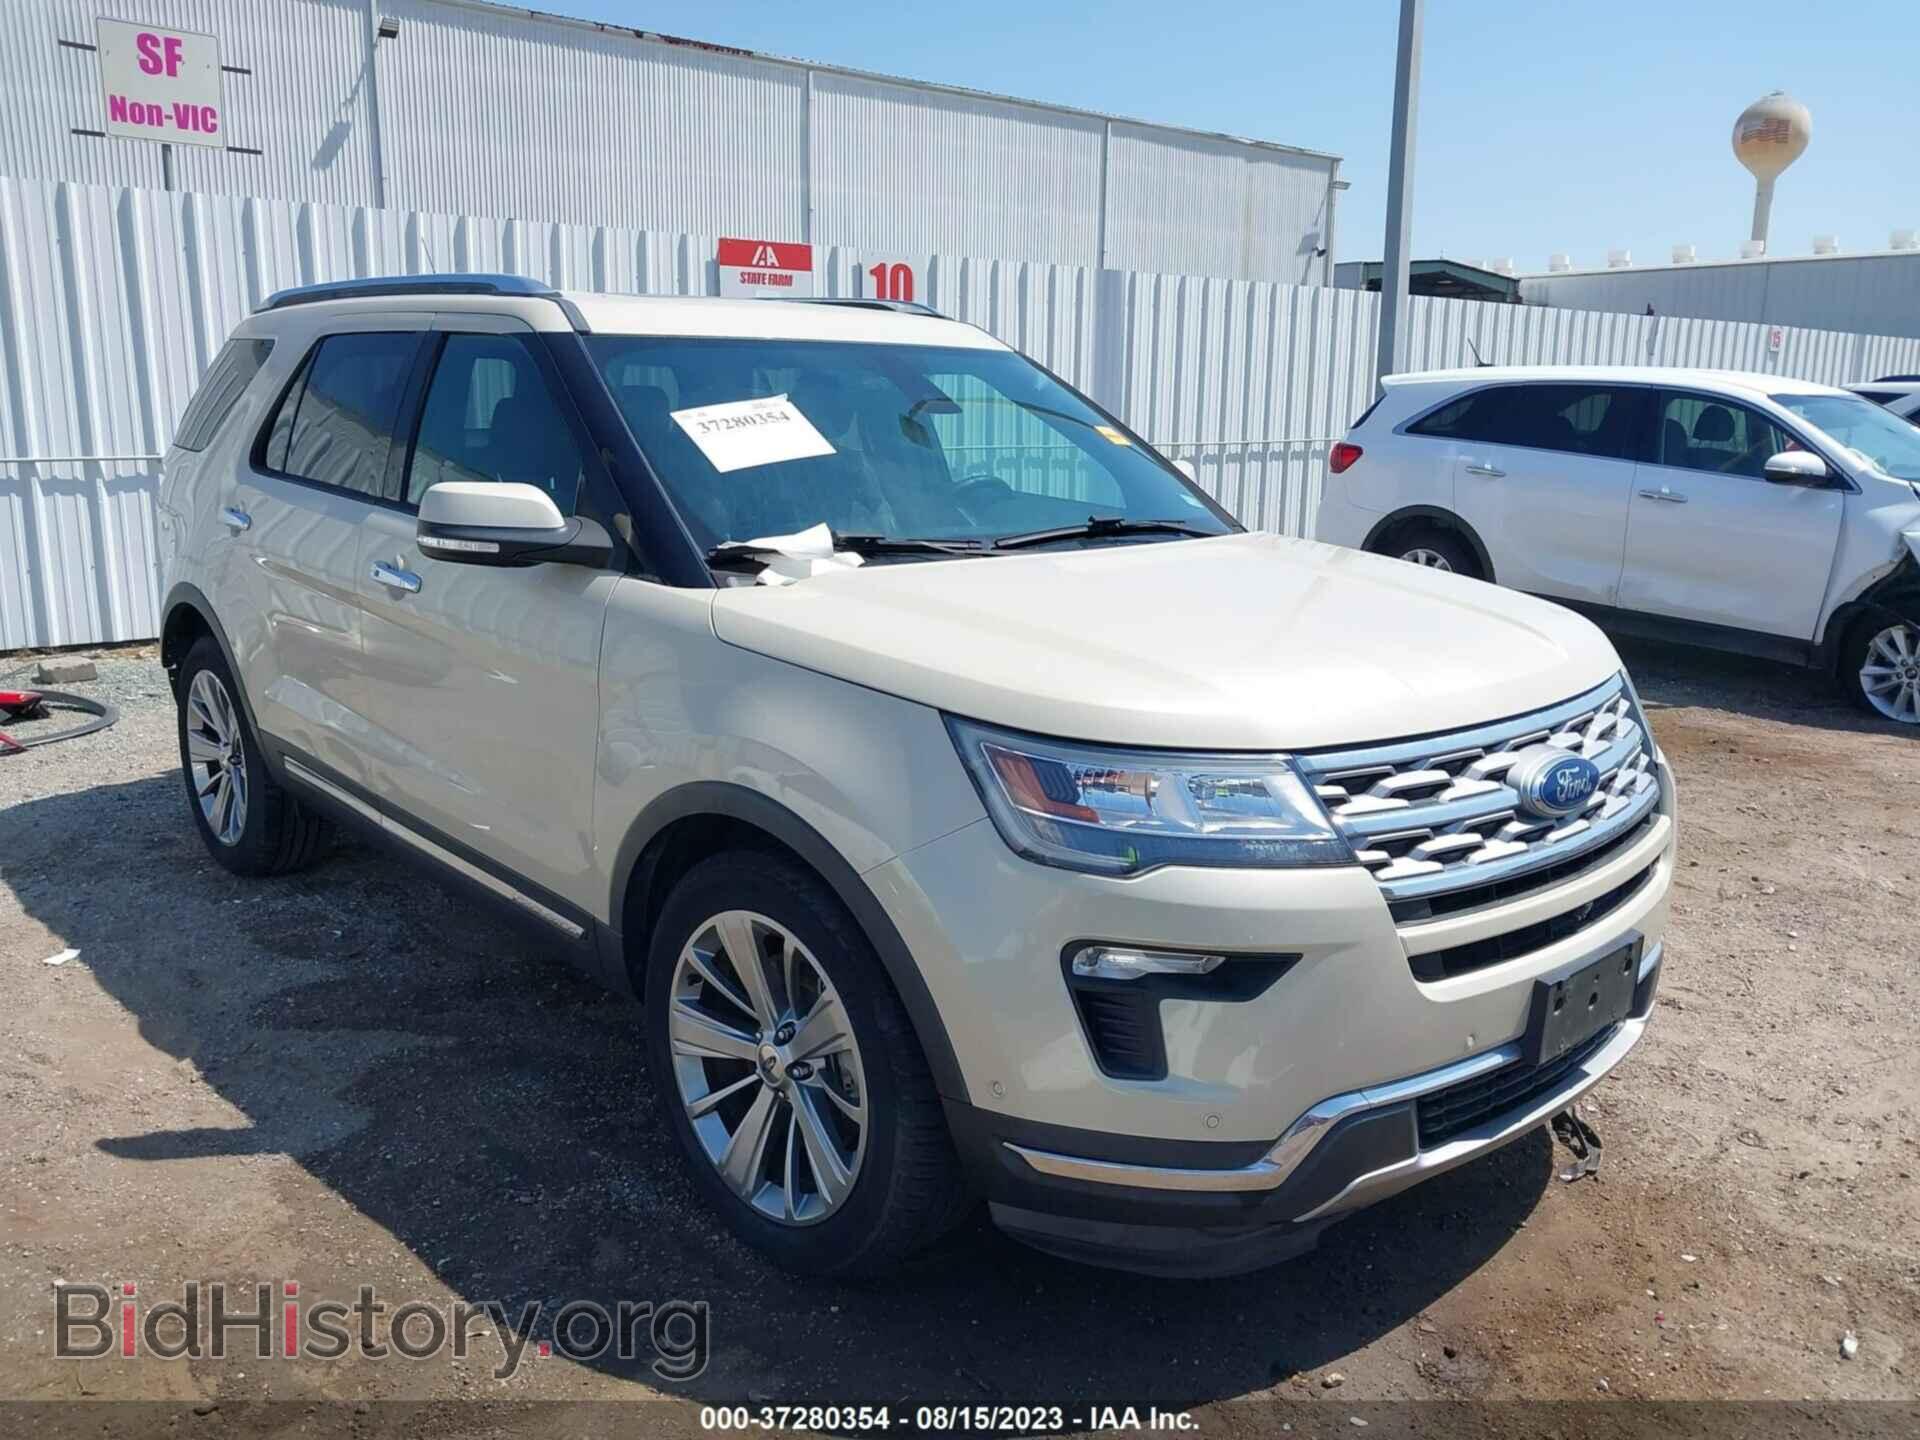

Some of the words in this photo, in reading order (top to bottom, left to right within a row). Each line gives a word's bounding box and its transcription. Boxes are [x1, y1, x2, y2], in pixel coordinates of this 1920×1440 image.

[137, 32, 182, 77] SF
[109, 94, 217, 133] Non-VIC
[740, 271, 766, 285] STATE
[768, 274, 793, 287] FARM
[869, 262, 914, 302] 10
[697, 410, 791, 434] 37280354
[1556, 766, 1592, 802] Ford
